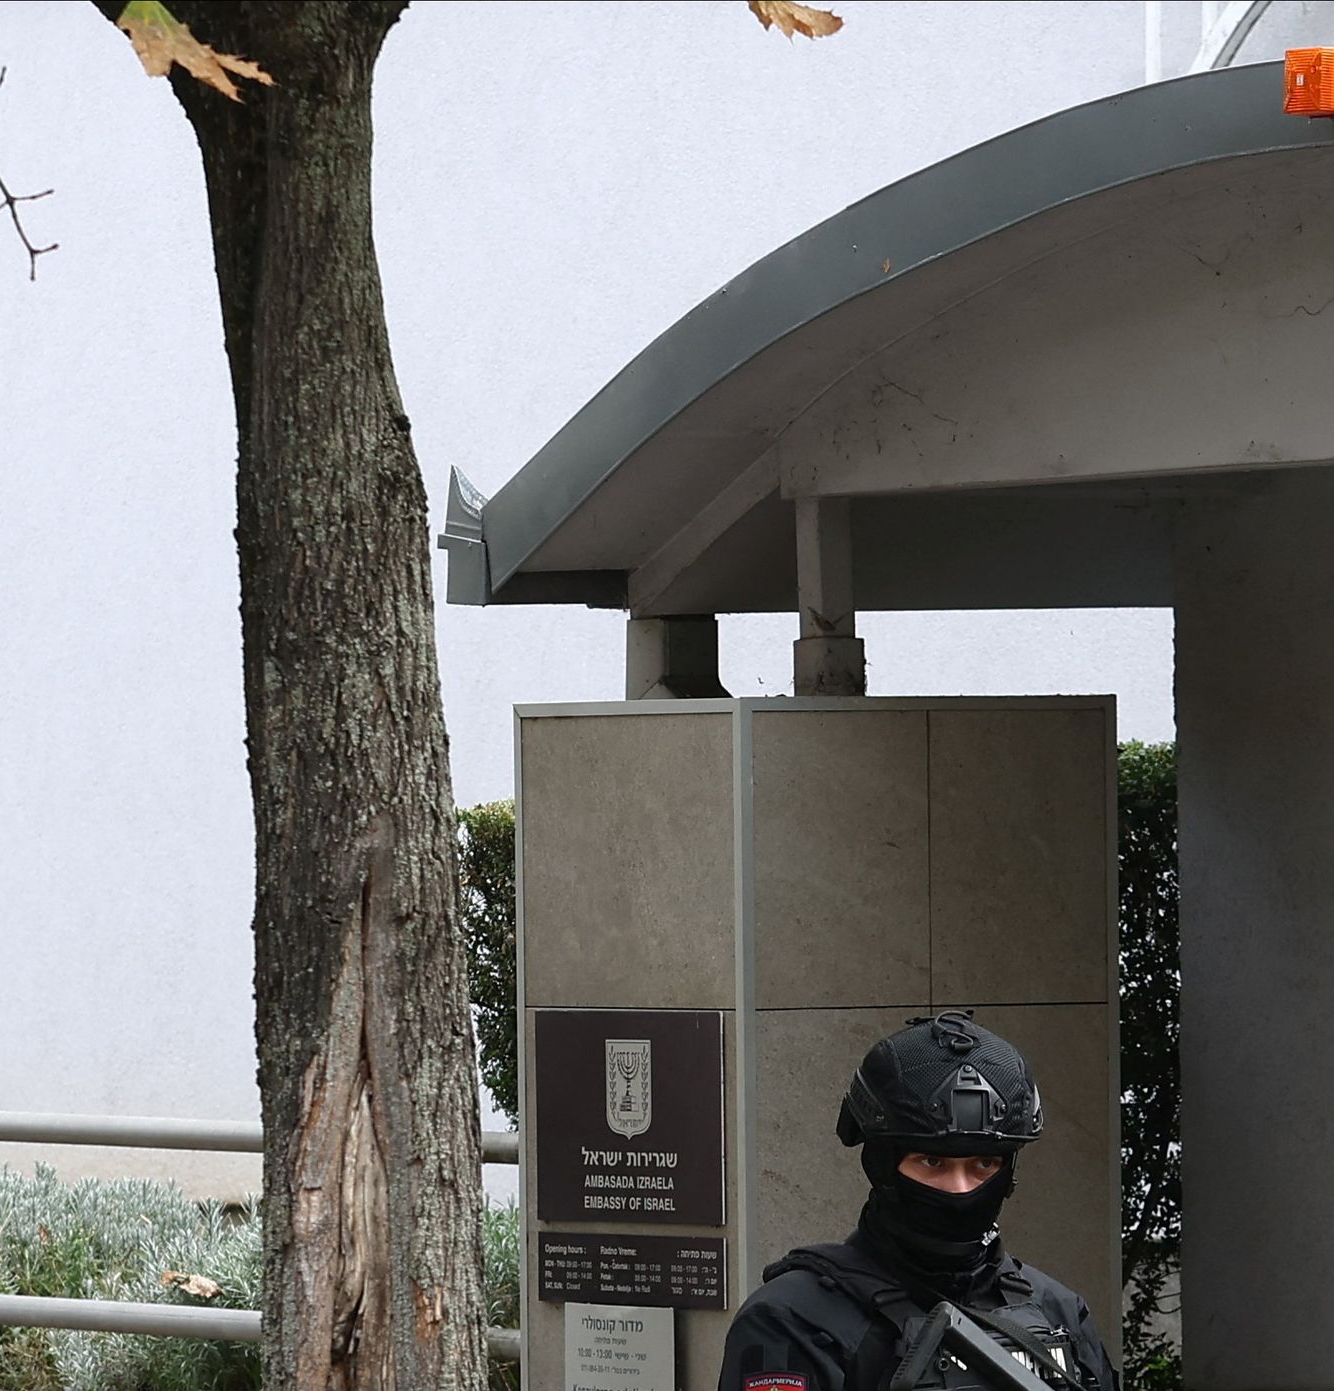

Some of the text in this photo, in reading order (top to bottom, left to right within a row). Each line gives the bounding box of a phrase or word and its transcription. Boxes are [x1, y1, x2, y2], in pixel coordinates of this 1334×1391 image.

[581, 1146, 677, 1168] שגרירות ישראל
[585, 1175, 674, 1190] AMBASADA IZRAELA
[584, 1196, 675, 1211] EMBASSY OF ISRAEL
[581, 1315, 644, 1334] מדור קונסולרי
